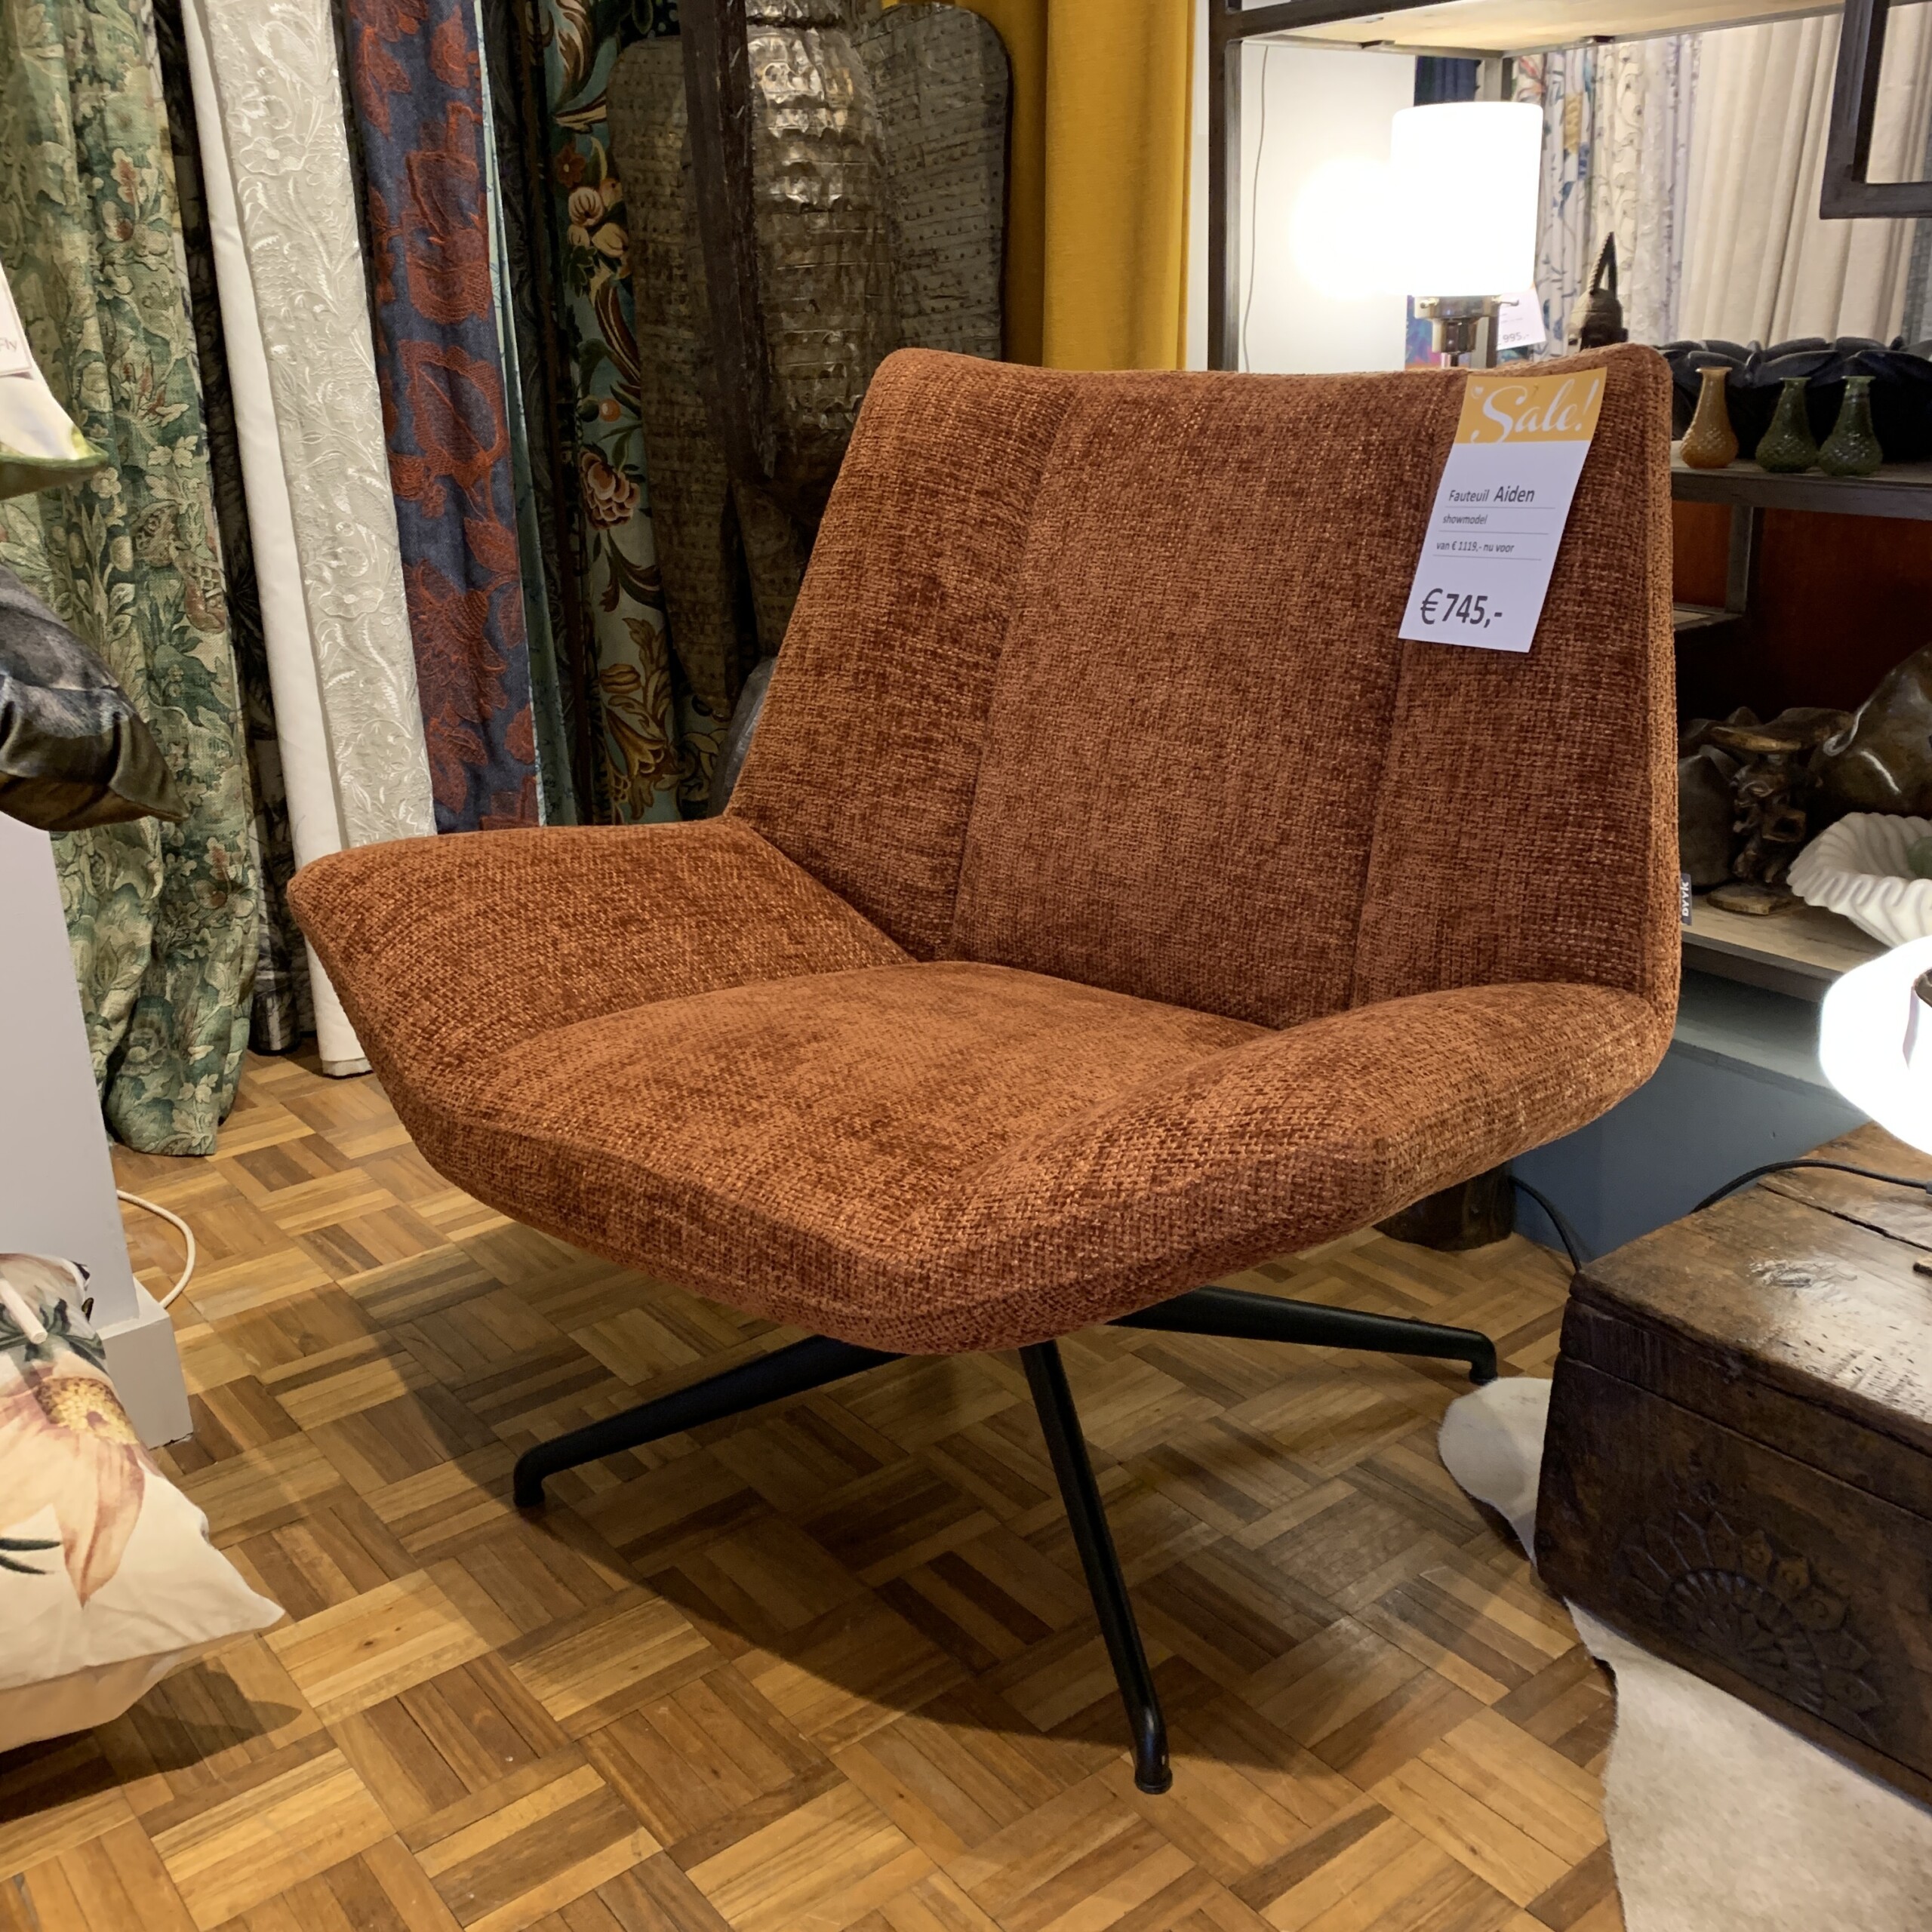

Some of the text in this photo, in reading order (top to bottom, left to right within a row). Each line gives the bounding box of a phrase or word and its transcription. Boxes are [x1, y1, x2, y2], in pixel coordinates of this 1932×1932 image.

[1498, 332, 1530, 345] 995,-
[1470, 378, 1599, 444] Sale!
[1449, 485, 1535, 503] Fauteuil Aiden
[1442, 514, 1487, 525] showmodel
[1496, 544, 1515, 552] voor
[1420, 588, 1503, 629] €745,-
